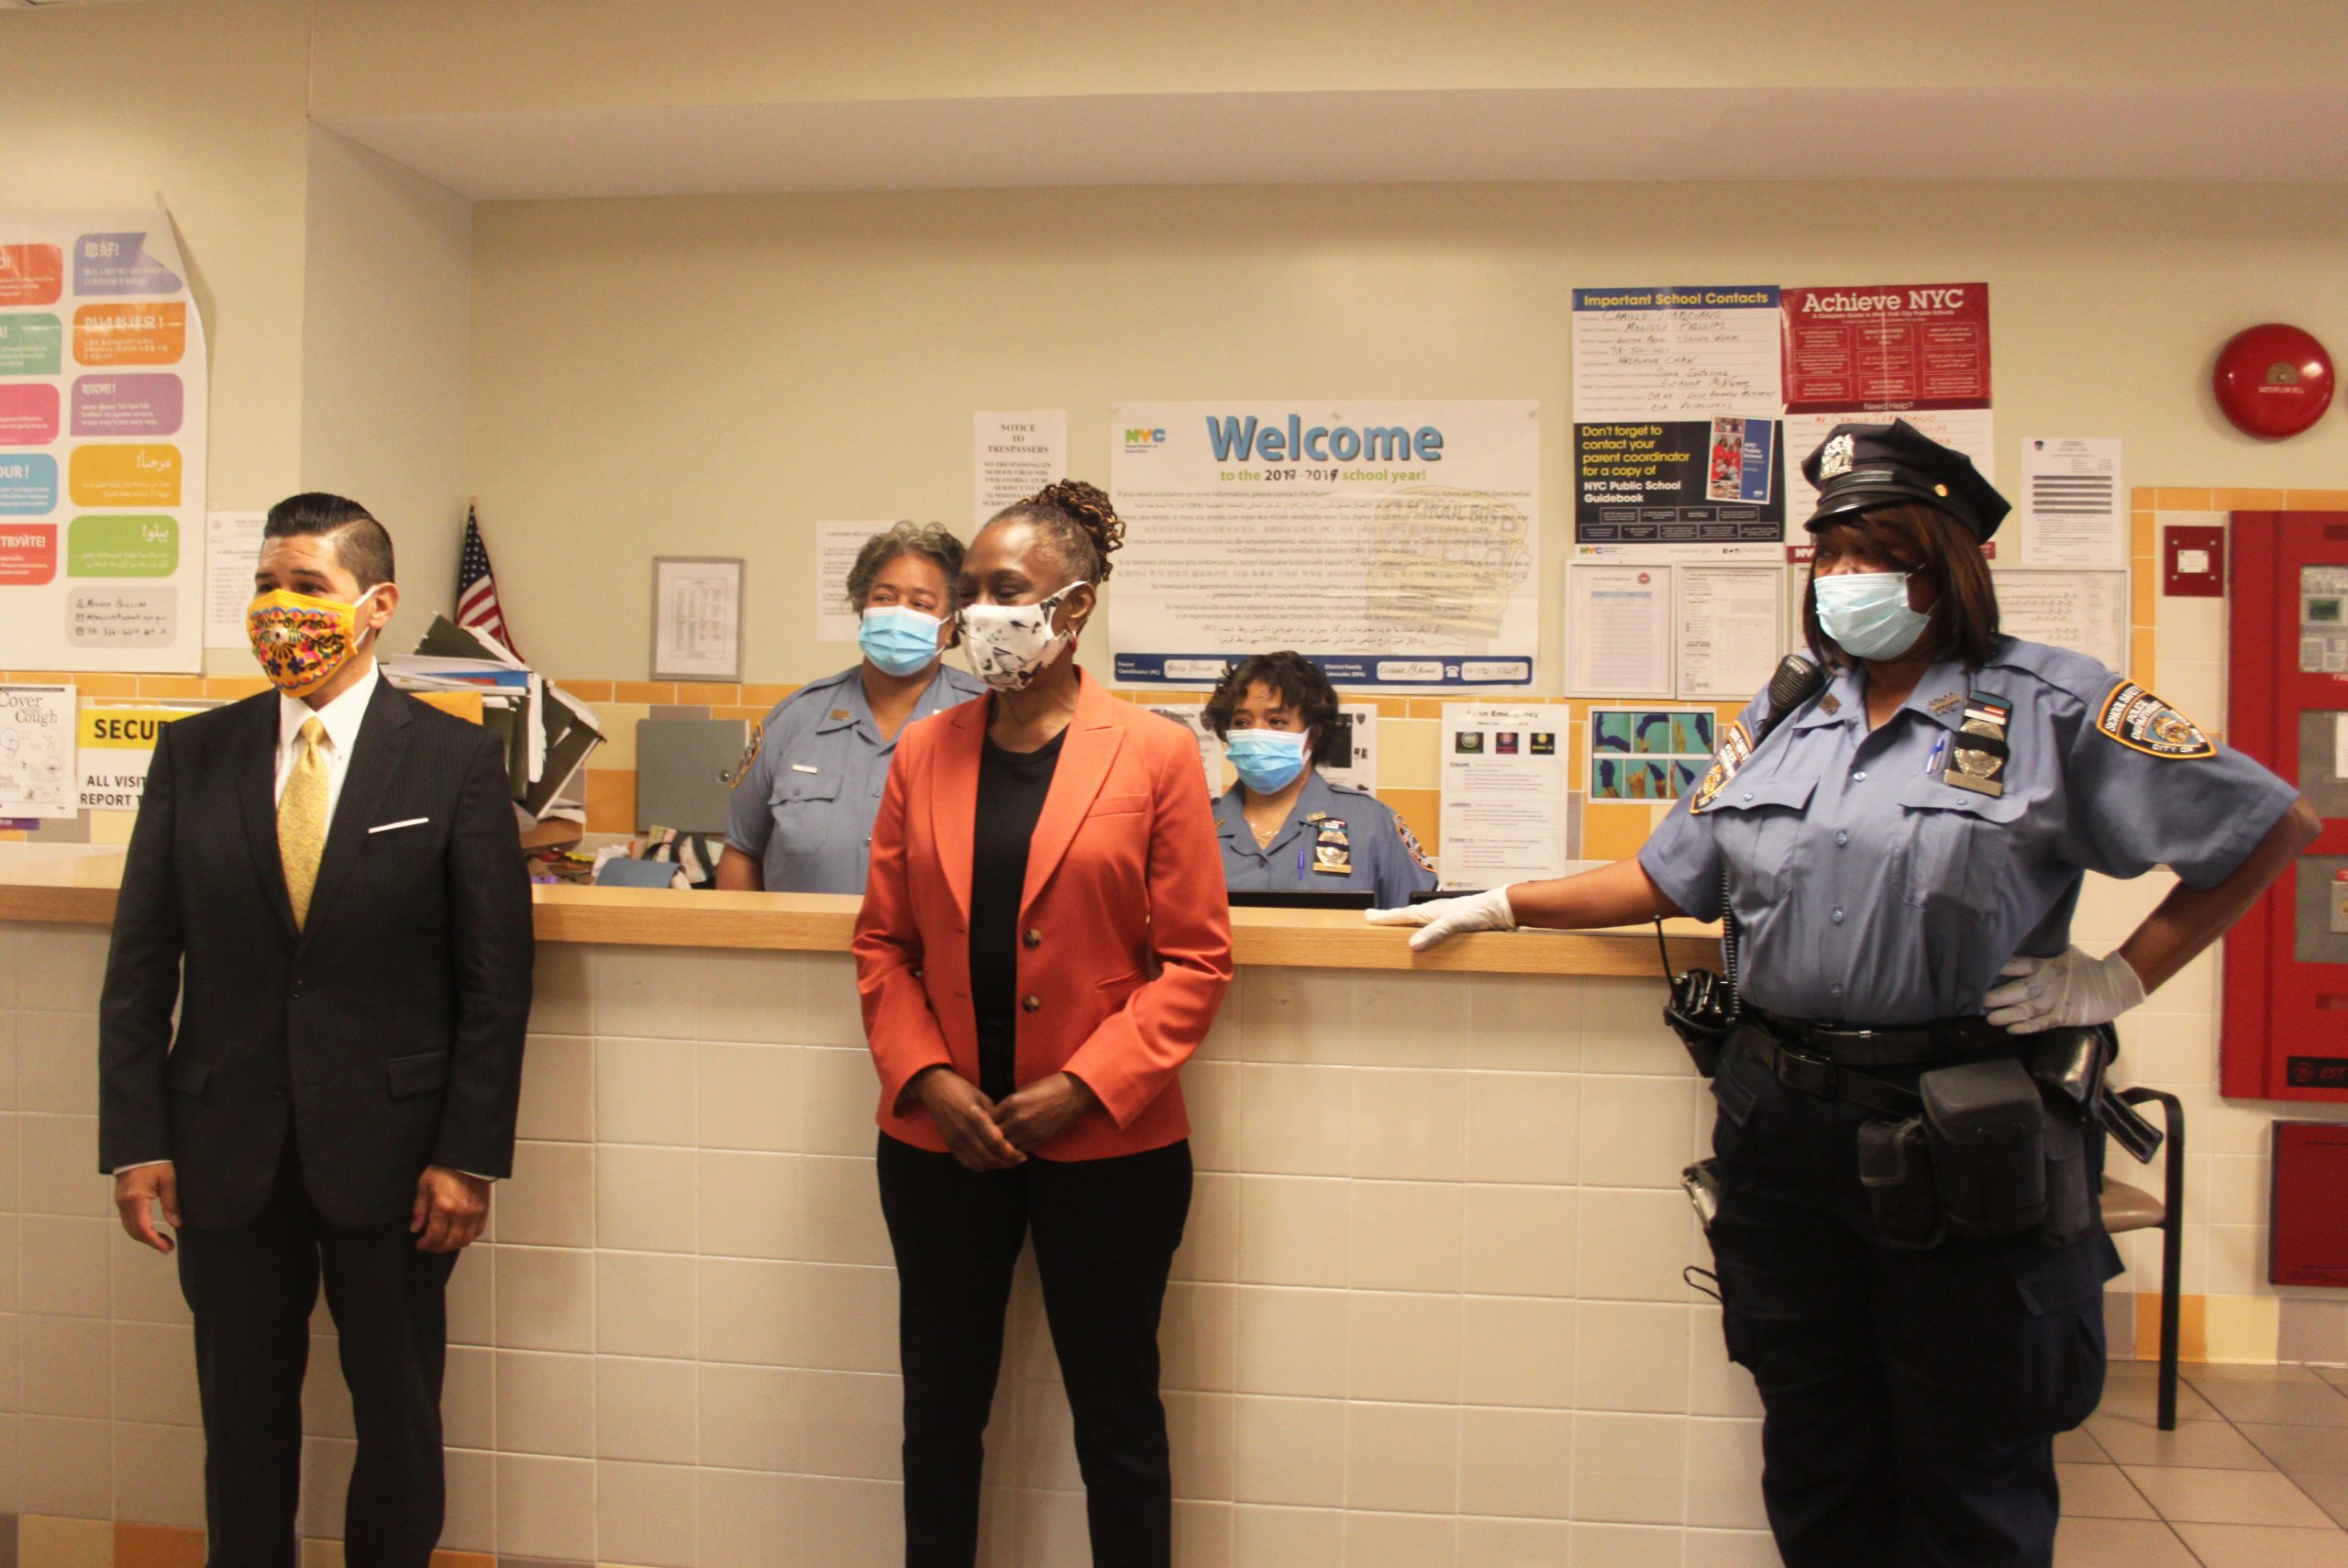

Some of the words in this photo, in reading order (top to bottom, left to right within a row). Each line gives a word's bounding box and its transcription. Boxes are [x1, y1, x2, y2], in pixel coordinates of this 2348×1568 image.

[1584, 295, 1652, 308] Important
[1655, 293, 1702, 305] School
[1705, 293, 1769, 304] Contacts
[1802, 293, 1902, 314] Achieve
[1909, 289, 1965, 310] NYC
[1864, 403, 1888, 411] Need
[1889, 402, 1913, 411] Help?
[1125, 429, 1166, 443] NYC
[1206, 414, 1444, 462] Welcome
[1582, 426, 1612, 437] Don't
[1614, 425, 1648, 439] forget
[1650, 425, 1662, 436] to
[1582, 439, 1627, 450] contact
[1629, 440, 1655, 451] your
[1583, 454, 1621, 465] parent
[1623, 452, 1689, 463] coordinator
[1221, 470, 1235, 480] to
[1238, 469, 1261, 480] the
[1343, 469, 1387, 480] school
[1391, 469, 1426, 483] year!
[1582, 466, 1598, 476] for
[1600, 468, 1609, 476] a
[1611, 468, 1642, 478] copy
[1644, 465, 1656, 476] of
[1584, 481, 1607, 491] NYC
[1610, 481, 1643, 491] Public
[1645, 480, 1681, 491] School
[1584, 493, 1644, 503] Guidebook
[1795, 548, 1815, 558] NY
[15, 709, 58, 727] Cough
[2152, 743, 2177, 753] CITY
[87, 775, 110, 788] ALL
[80, 793, 132, 806] REPORT
